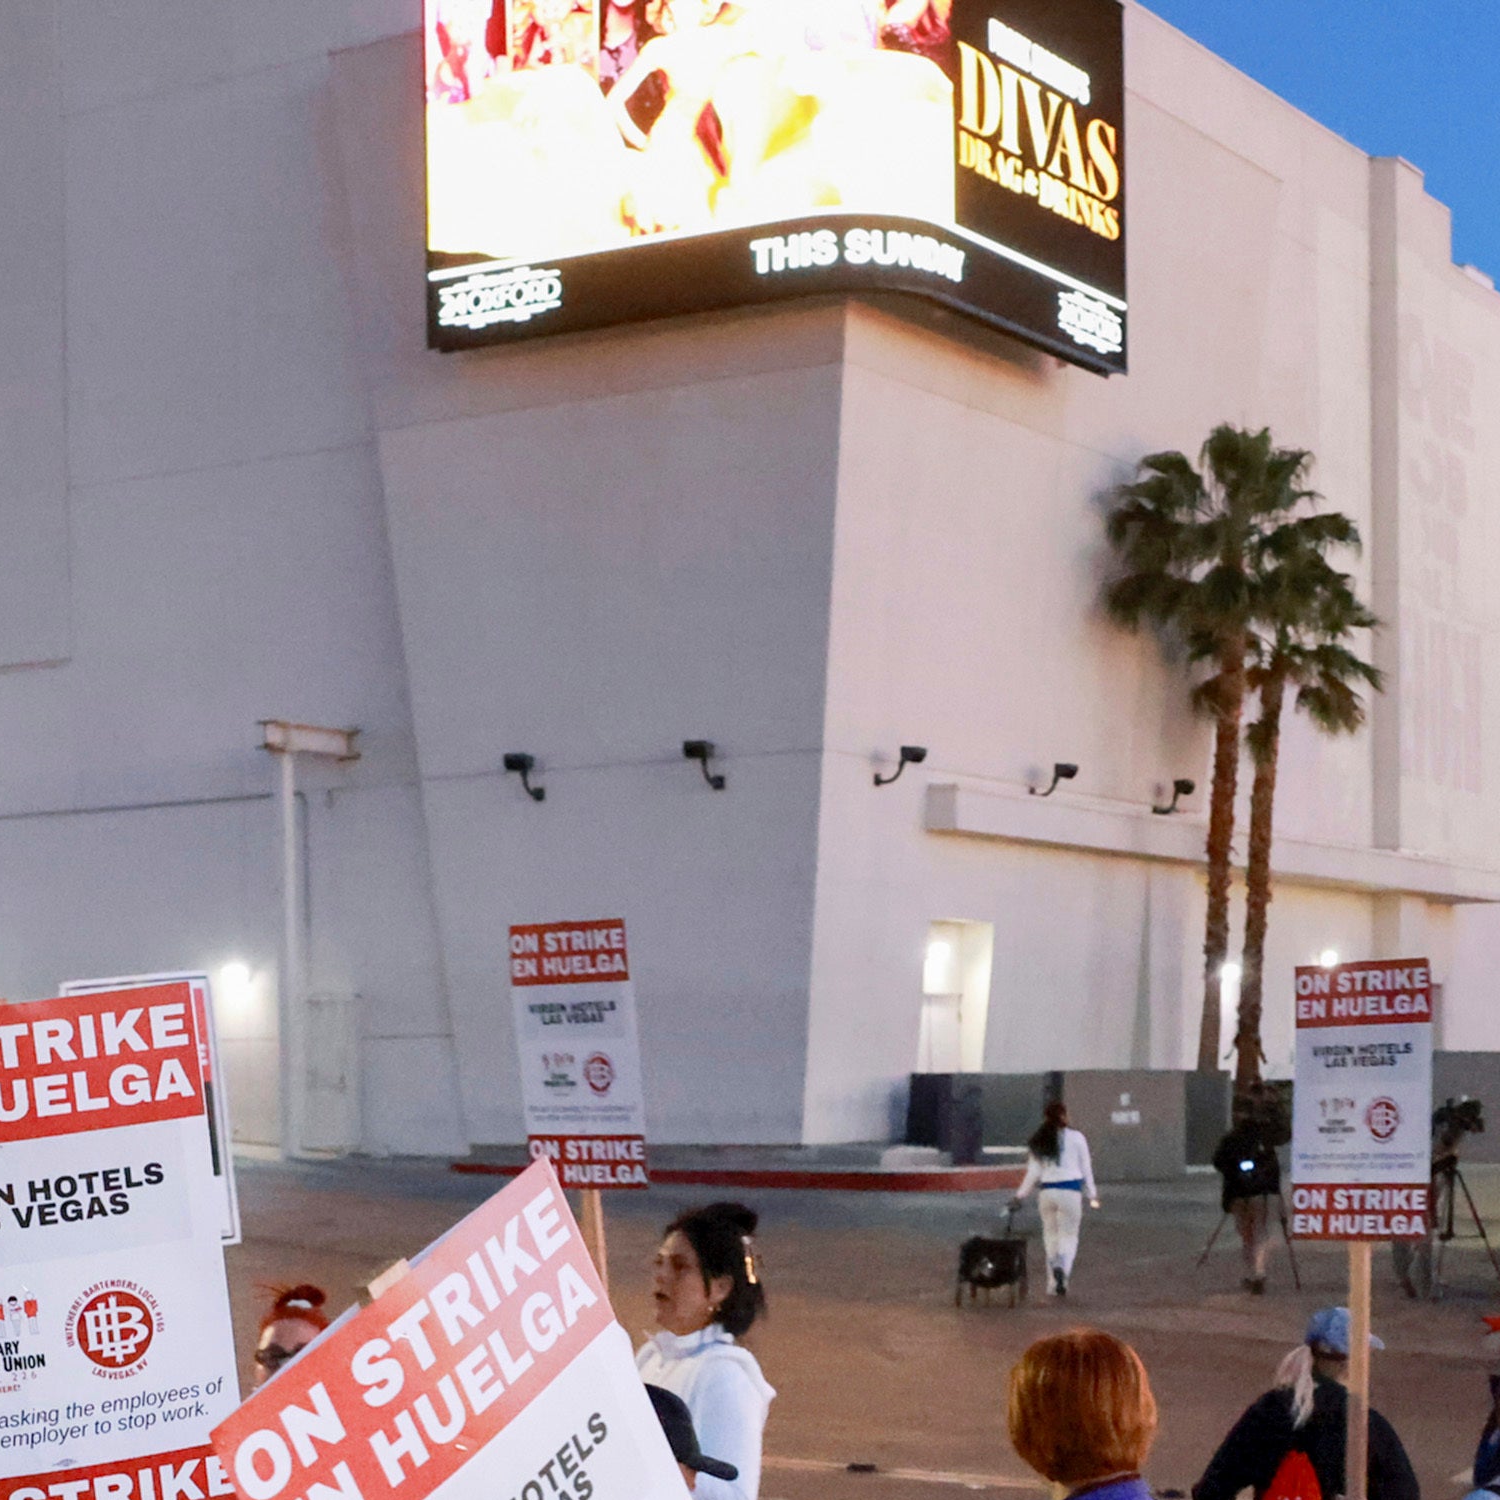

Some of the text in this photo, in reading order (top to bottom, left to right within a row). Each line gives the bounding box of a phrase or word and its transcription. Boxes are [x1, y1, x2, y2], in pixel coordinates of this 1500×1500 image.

[957, 41, 1119, 201] DIVAS
[958, 130, 1120, 240] DRAG & DRINKS
[750, 229, 839, 274] THIS
[512, 928, 624, 953] ON STRIKE
[513, 954, 626, 977] EN HUELGA
[1297, 967, 1428, 994] ON STRIKE
[1297, 994, 1428, 1019] EN HUELGA
[566, 1140, 645, 1159] STRIKE
[29, 1162, 164, 1201] HOTELS
[565, 1165, 647, 1184] HUELGA
[13, 1193, 129, 1228] VEGAS
[1294, 1189, 1427, 1210] ON STRIKE
[1294, 1214, 1426, 1234] EN HUELGA
[350, 1187, 573, 1409] STRIKE
[4, 1354, 46, 1372] UNION
[370, 1262, 599, 1489] HUELGA
[12, 1372, 38, 1382] 226
[66, 1402, 94, 1421] the
[101, 1387, 201, 1417] employees
[205, 1377, 224, 1397] of
[0, 1424, 88, 1453] employer
[94, 1419, 112, 1434] to
[118, 1413, 157, 1434] stop
[162, 1402, 210, 1423] work.
